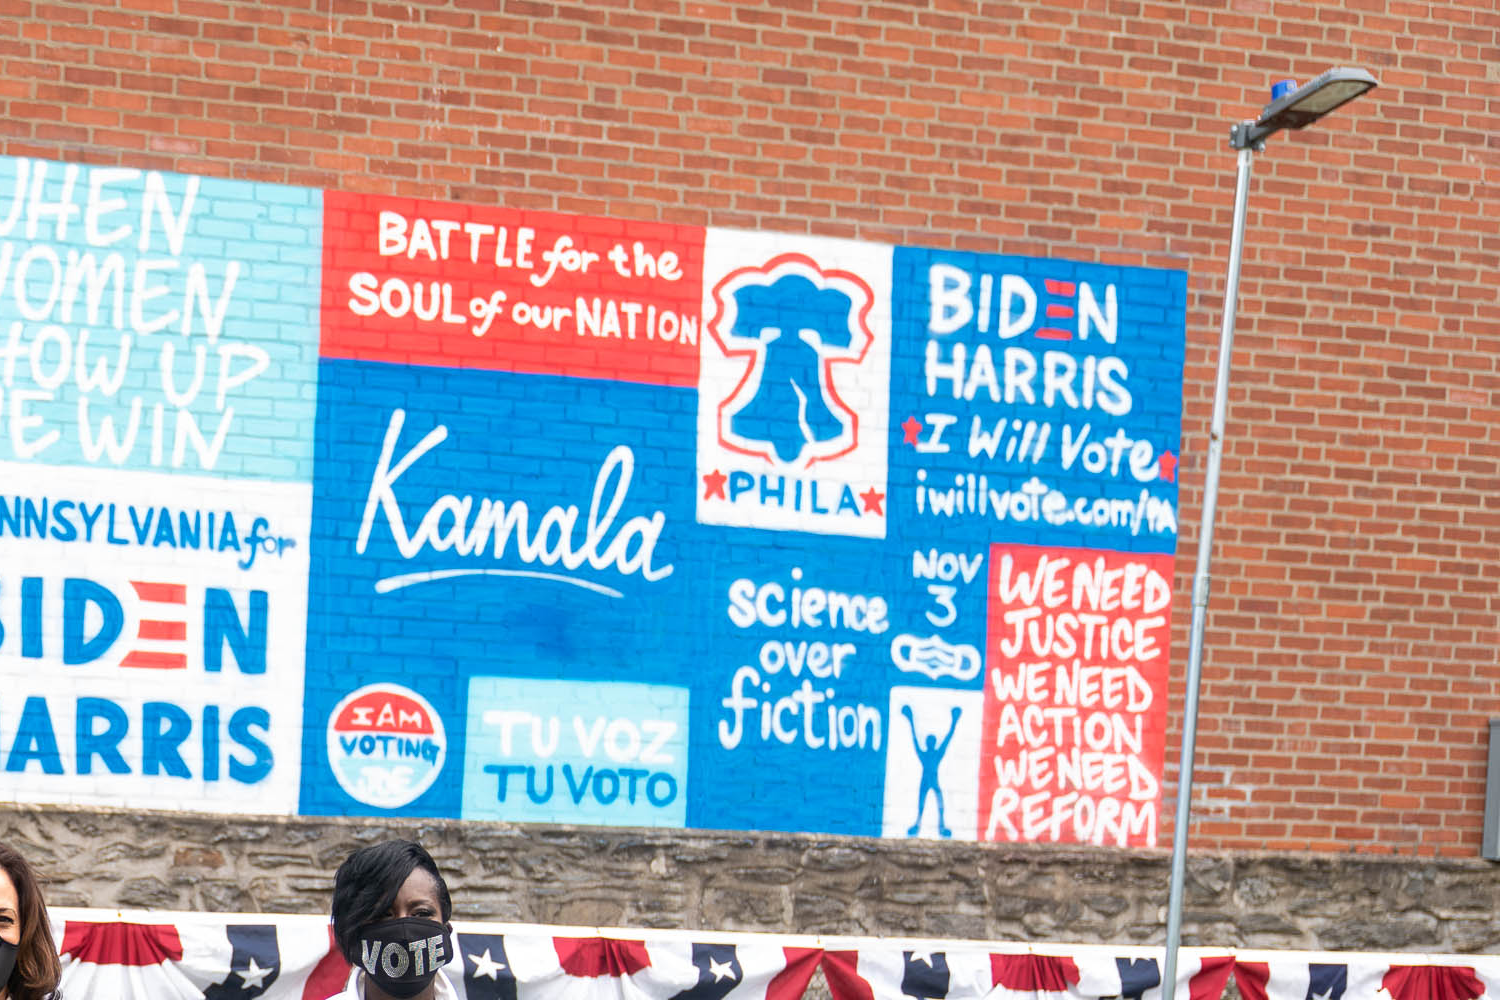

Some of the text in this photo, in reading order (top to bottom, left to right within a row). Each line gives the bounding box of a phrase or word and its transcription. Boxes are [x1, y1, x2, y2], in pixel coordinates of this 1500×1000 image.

[378, 211, 683, 286] BATTLE for the
[348, 272, 698, 346] SOUL of our NATION
[928, 264, 1118, 344] BIDEN
[160, 341, 270, 412] UP
[925, 340, 1134, 416] HARRIS
[76, 396, 235, 470] WIN
[918, 413, 958, 453] I
[1061, 423, 1160, 483] Vote
[356, 408, 674, 582] Kamala
[729, 470, 862, 518] PHILA
[237, 516, 296, 571] for
[912, 548, 983, 584] NOV
[728, 567, 890, 634] science
[926, 584, 957, 627] 3
[1000, 553, 1172, 613] WE NEED
[759, 640, 856, 678] over
[999, 608, 1166, 662] JUSTICE
[717, 665, 881, 751] fiction
[991, 662, 1153, 713] WE NEED
[375, 702, 423, 729] AM
[483, 712, 678, 764] TU VOZ
[999, 706, 1143, 753] ACTION
[339, 735, 440, 767] VOTING
[994, 747, 1160, 800] WE NEED
[483, 764, 679, 808] TU VOTO
[984, 787, 1157, 847] REFORM
[361, 934, 447, 978] VOTE
